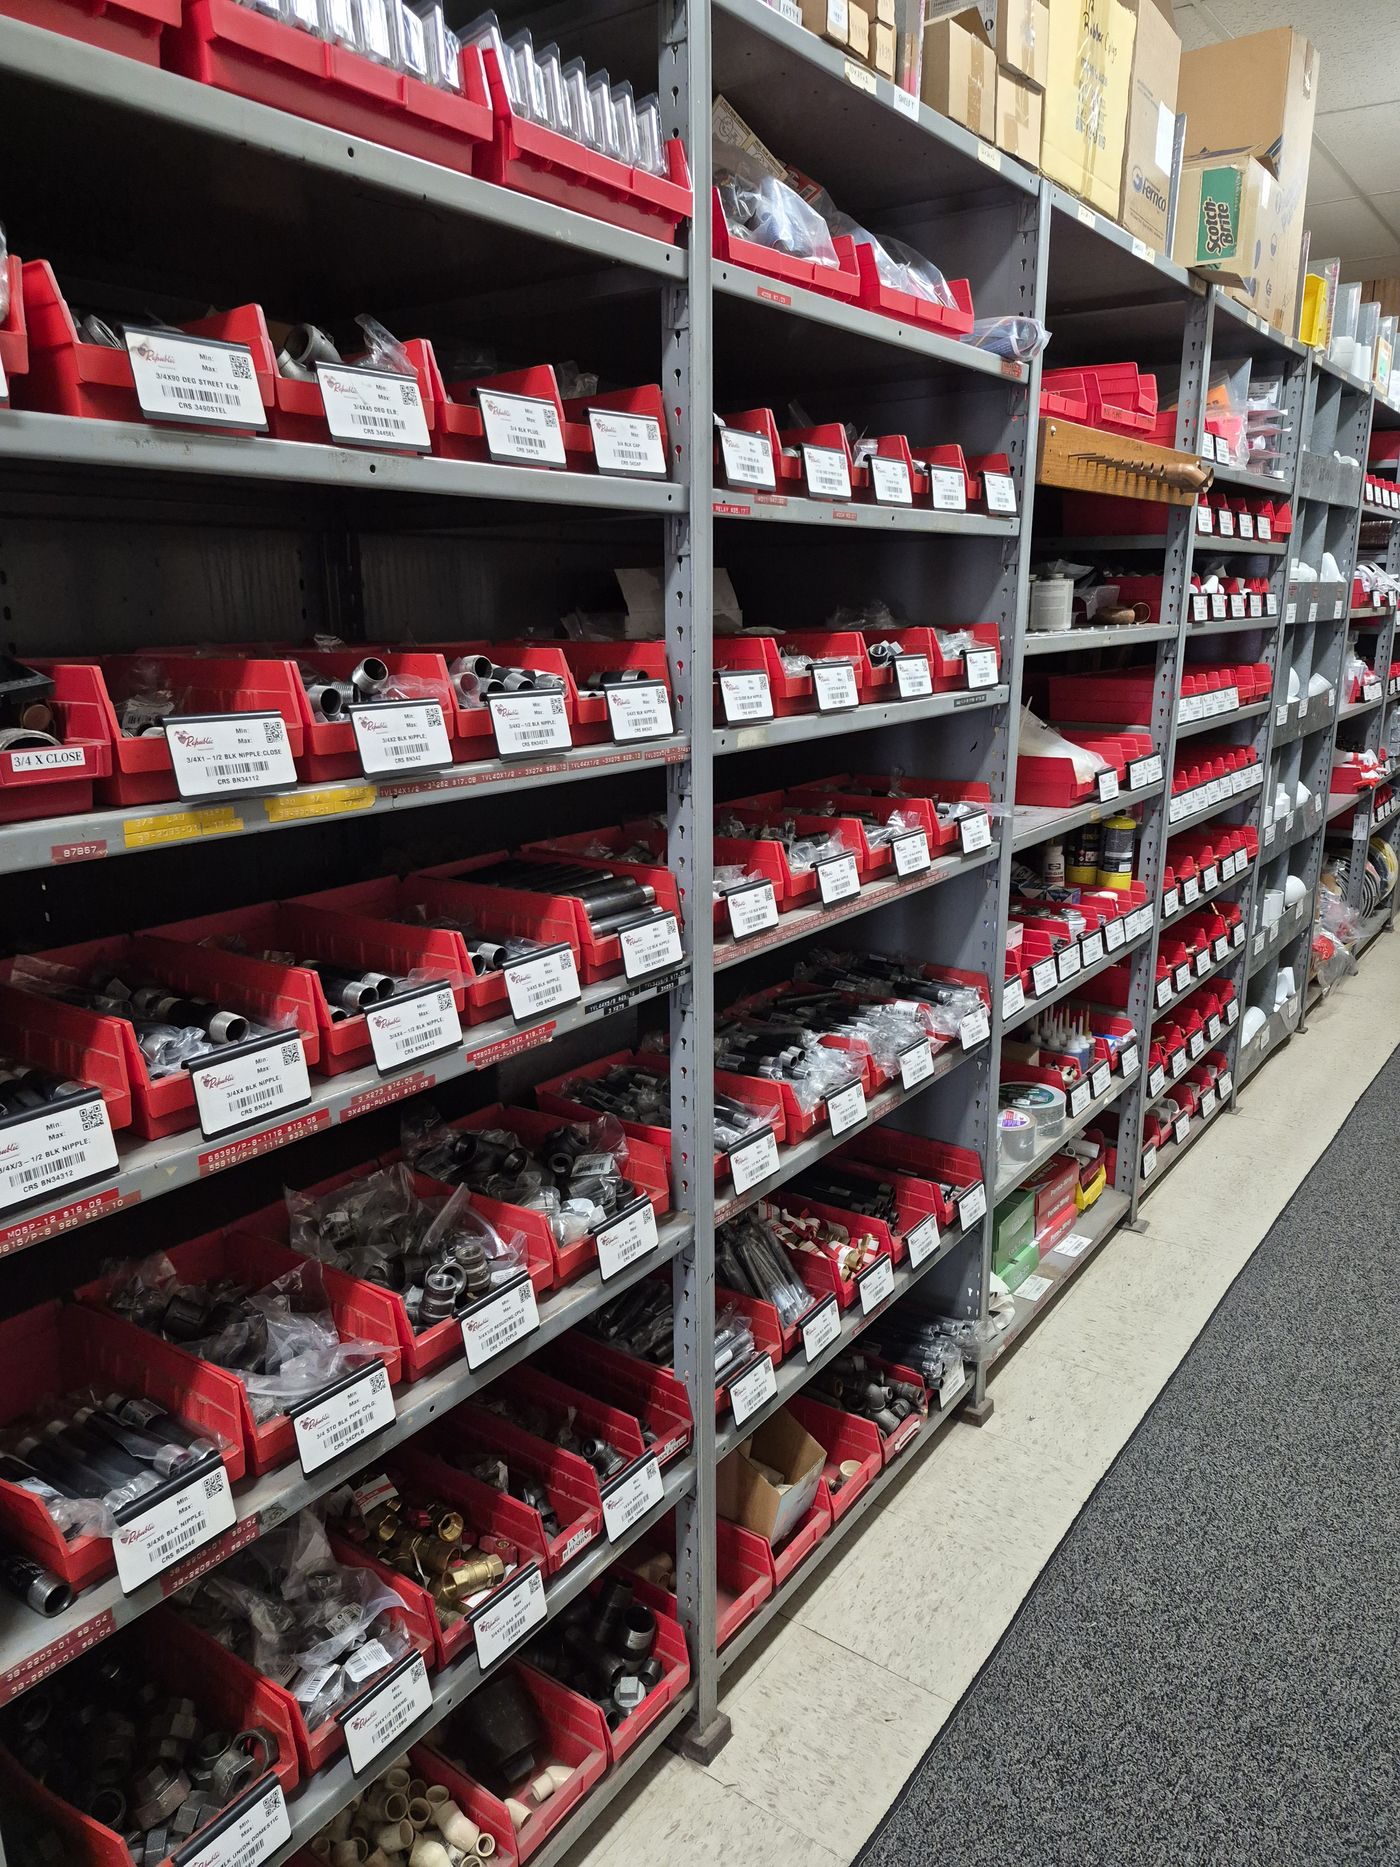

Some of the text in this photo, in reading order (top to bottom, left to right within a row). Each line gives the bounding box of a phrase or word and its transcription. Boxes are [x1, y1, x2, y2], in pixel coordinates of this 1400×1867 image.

[1142, 178, 1167, 213] Fernco
[1217, 202, 1234, 248] Brite
[155, 372, 180, 383] 3/4X90
[182, 376, 197, 385] DEG
[198, 379, 224, 389] STREET
[178, 402, 193, 411] CRS
[374, 406, 386, 415] DEG
[363, 428, 375, 436] CRS
[14, 751, 83, 767] 3/4 X CLOSE
[186, 755, 205, 764] 3/4X1
[232, 775, 260, 783] BN34112
[226, 1087, 244, 1099] 3/4X4
[245, 1083, 257, 1092] BLK
[240, 1108, 253, 1117] CRS
[31, 1153, 43, 1162] 1/2
[45, 1149, 60, 1158] BLK
[23, 1170, 74, 1193] CRS BN34312
[349, 1410, 361, 1421] PIPE
[166, 1526, 179, 1537] BLK
[161, 1552, 174, 1564] CRS
